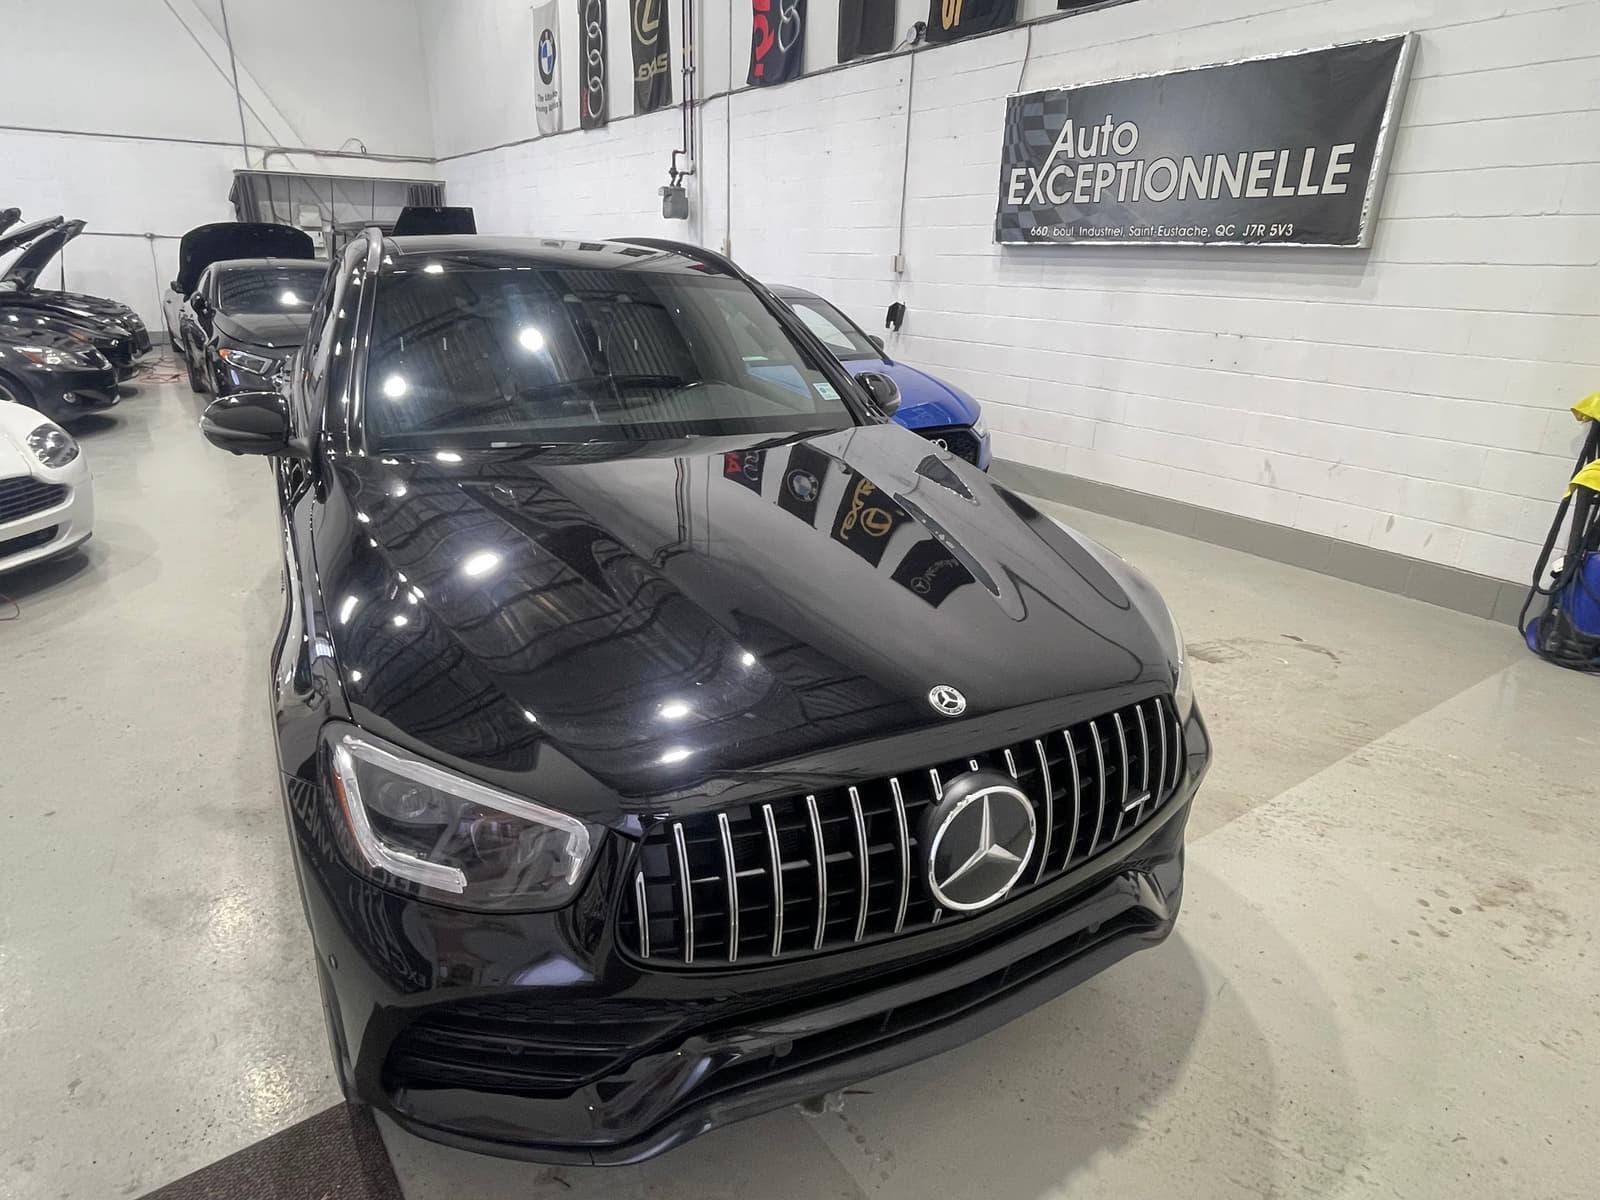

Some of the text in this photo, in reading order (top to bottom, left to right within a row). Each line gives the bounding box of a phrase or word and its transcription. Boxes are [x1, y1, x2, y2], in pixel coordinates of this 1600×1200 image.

[1047, 114, 1139, 159] Auto
[1007, 143, 1356, 206] EXCEPTIONNELLE
[1128, 225, 1211, 238] Saint-Eustache,
[1215, 224, 1236, 237] QC
[1242, 224, 1266, 237] J7R
[1269, 223, 1294, 237] 5V3
